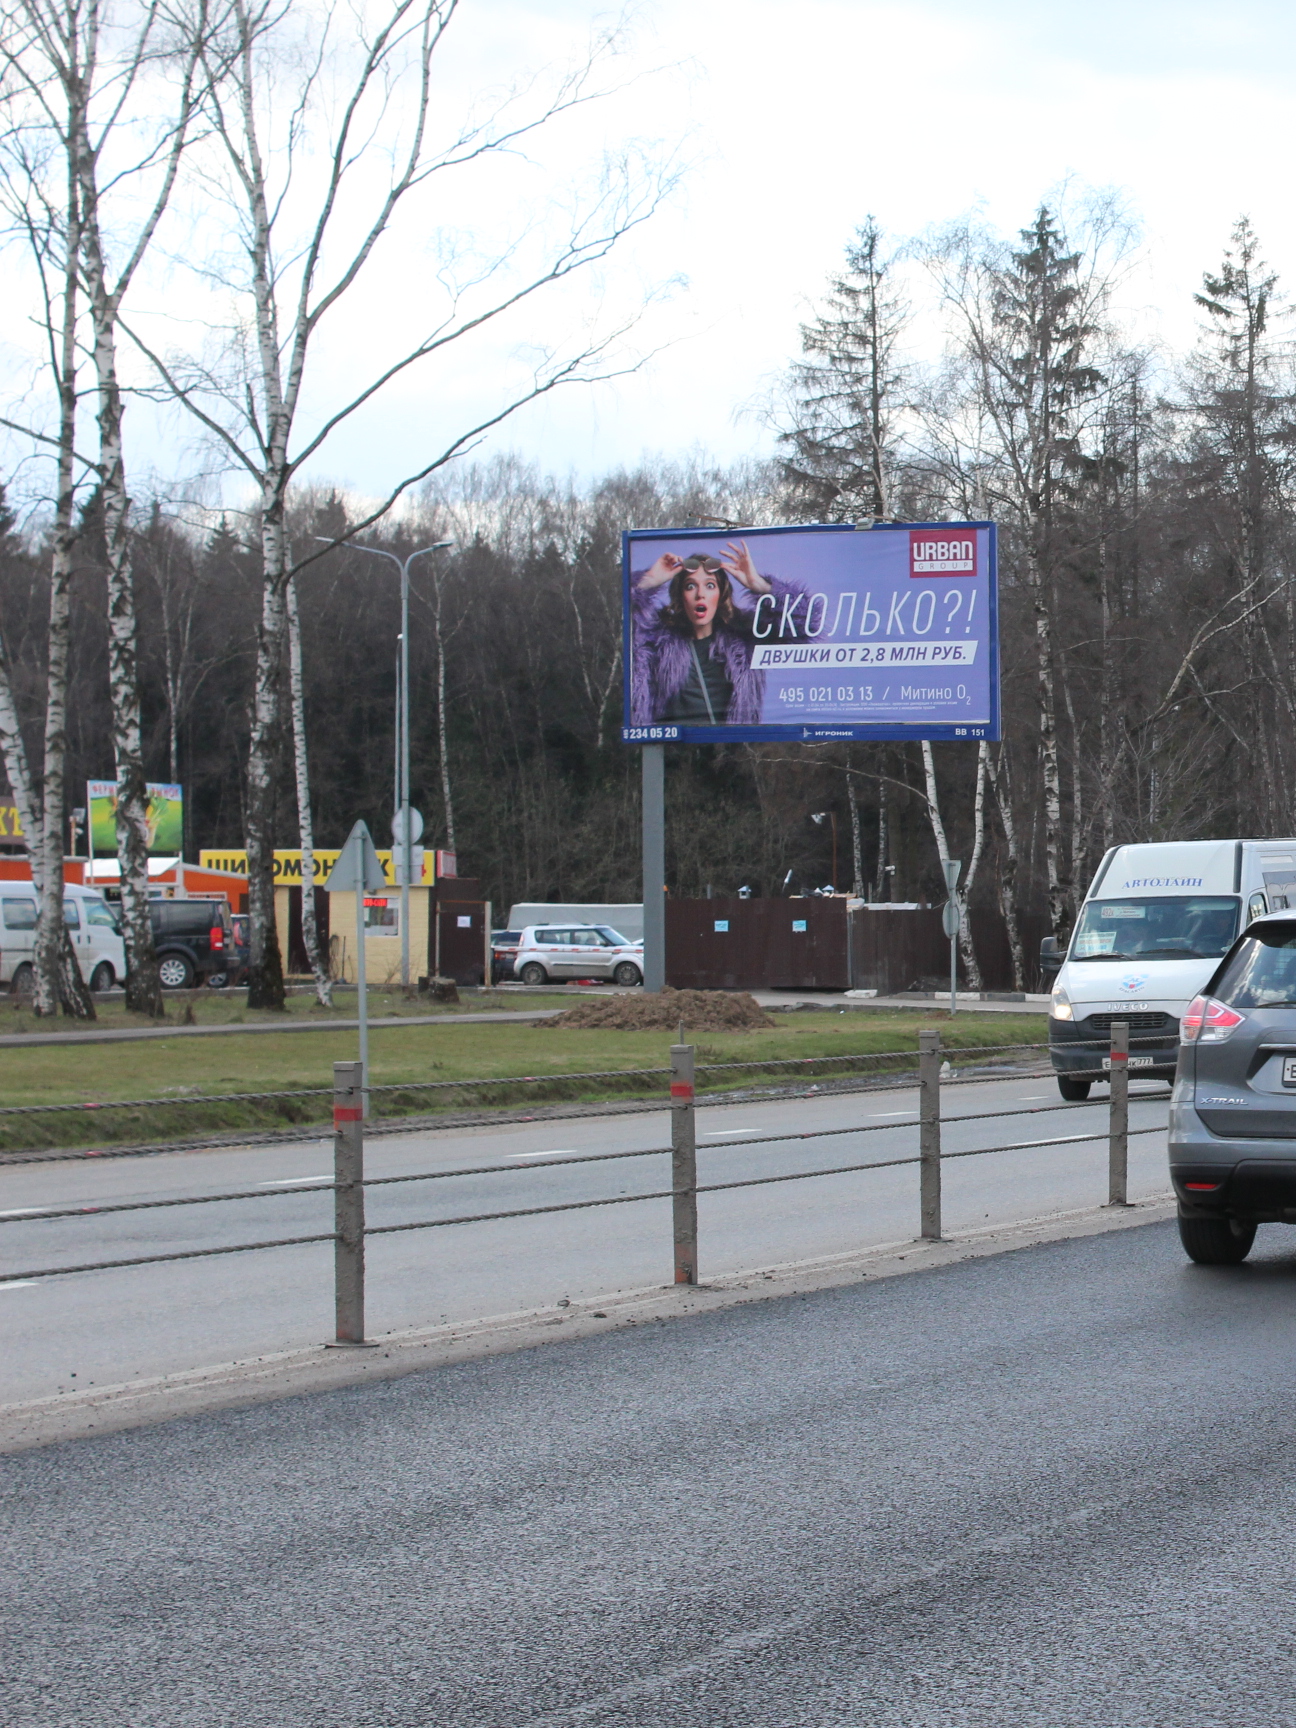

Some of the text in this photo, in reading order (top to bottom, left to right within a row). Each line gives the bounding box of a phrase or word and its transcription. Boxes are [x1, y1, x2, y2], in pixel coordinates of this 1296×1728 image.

[913, 541, 973, 560] URBAN
[918, 562, 968, 570] GROUP
[752, 589, 977, 639] СКОЛЬКО?!
[760, 645, 967, 666] ДВУШКИ ОТ 2,8 МЛН РУБ.
[779, 687, 804, 702] 495
[809, 687, 832, 701] 021
[837, 687, 853, 701] 03
[859, 686, 873, 700] 13
[901, 684, 952, 700] Митино
[629, 727, 678, 739] 234 05 20
[971, 728, 985, 737] 151
[1107, 1003, 1149, 1011] IVECO
[1200, 1097, 1248, 1105] X-TRAIL
